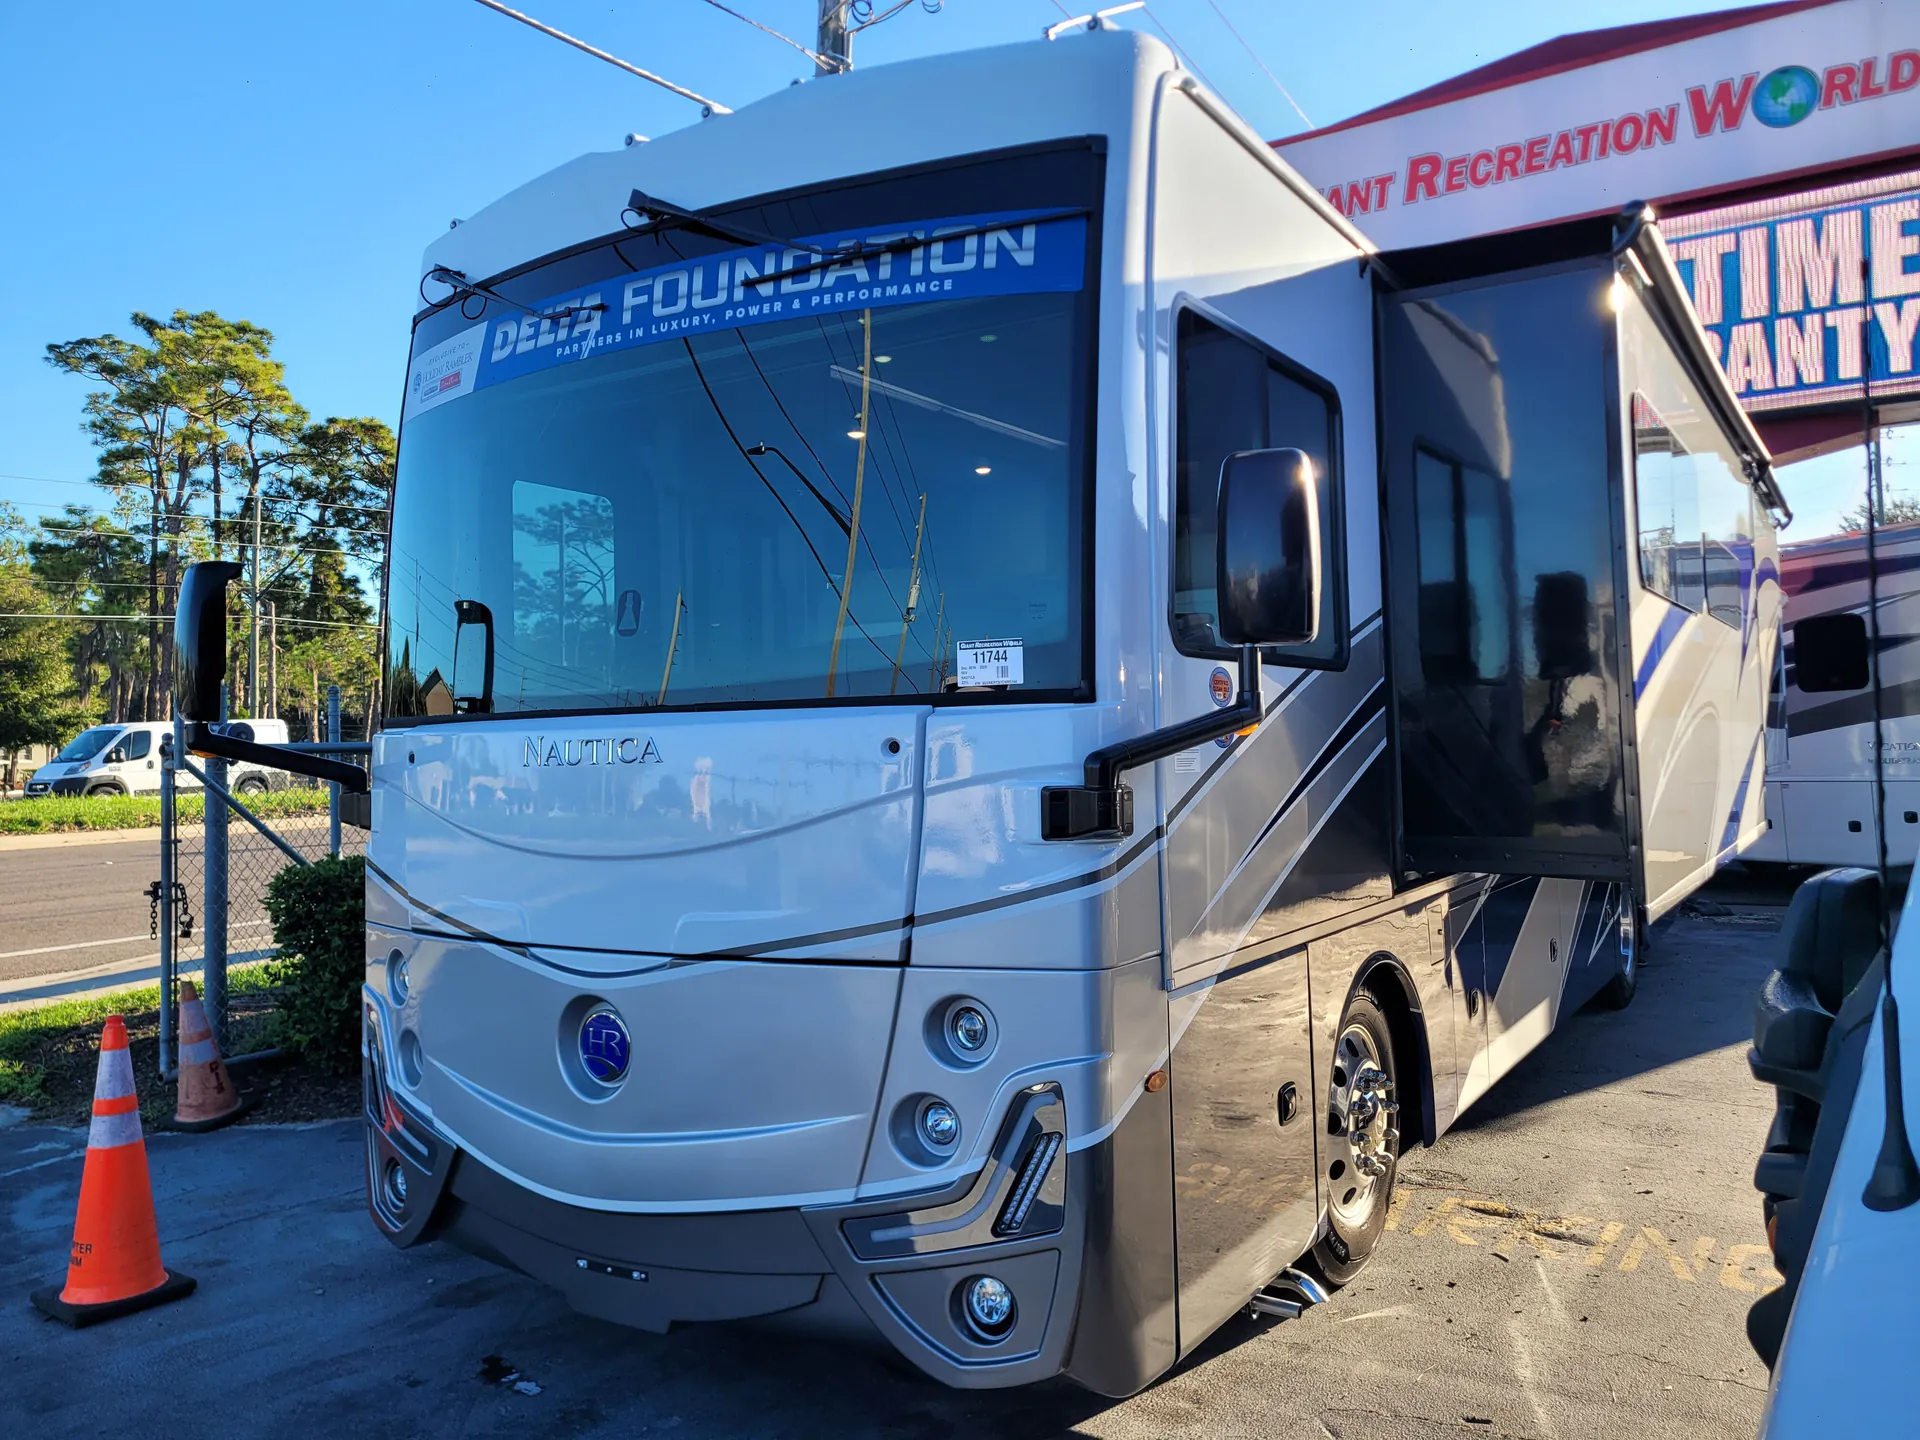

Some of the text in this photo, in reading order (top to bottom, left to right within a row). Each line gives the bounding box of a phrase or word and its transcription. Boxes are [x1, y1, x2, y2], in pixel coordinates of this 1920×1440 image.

[1318, 171, 1396, 218] ANT
[1403, 104, 1680, 204] RECREATION
[491, 222, 1036, 363] DELTA FOUNDATION
[1666, 199, 1920, 326] TIME
[556, 279, 953, 358] PARTNERS IN LUXURY, POWER & PERFORMANCE
[973, 650, 1008, 664] 11744
[523, 736, 663, 767] NAUTICA
[589, 1027, 621, 1057] HR
